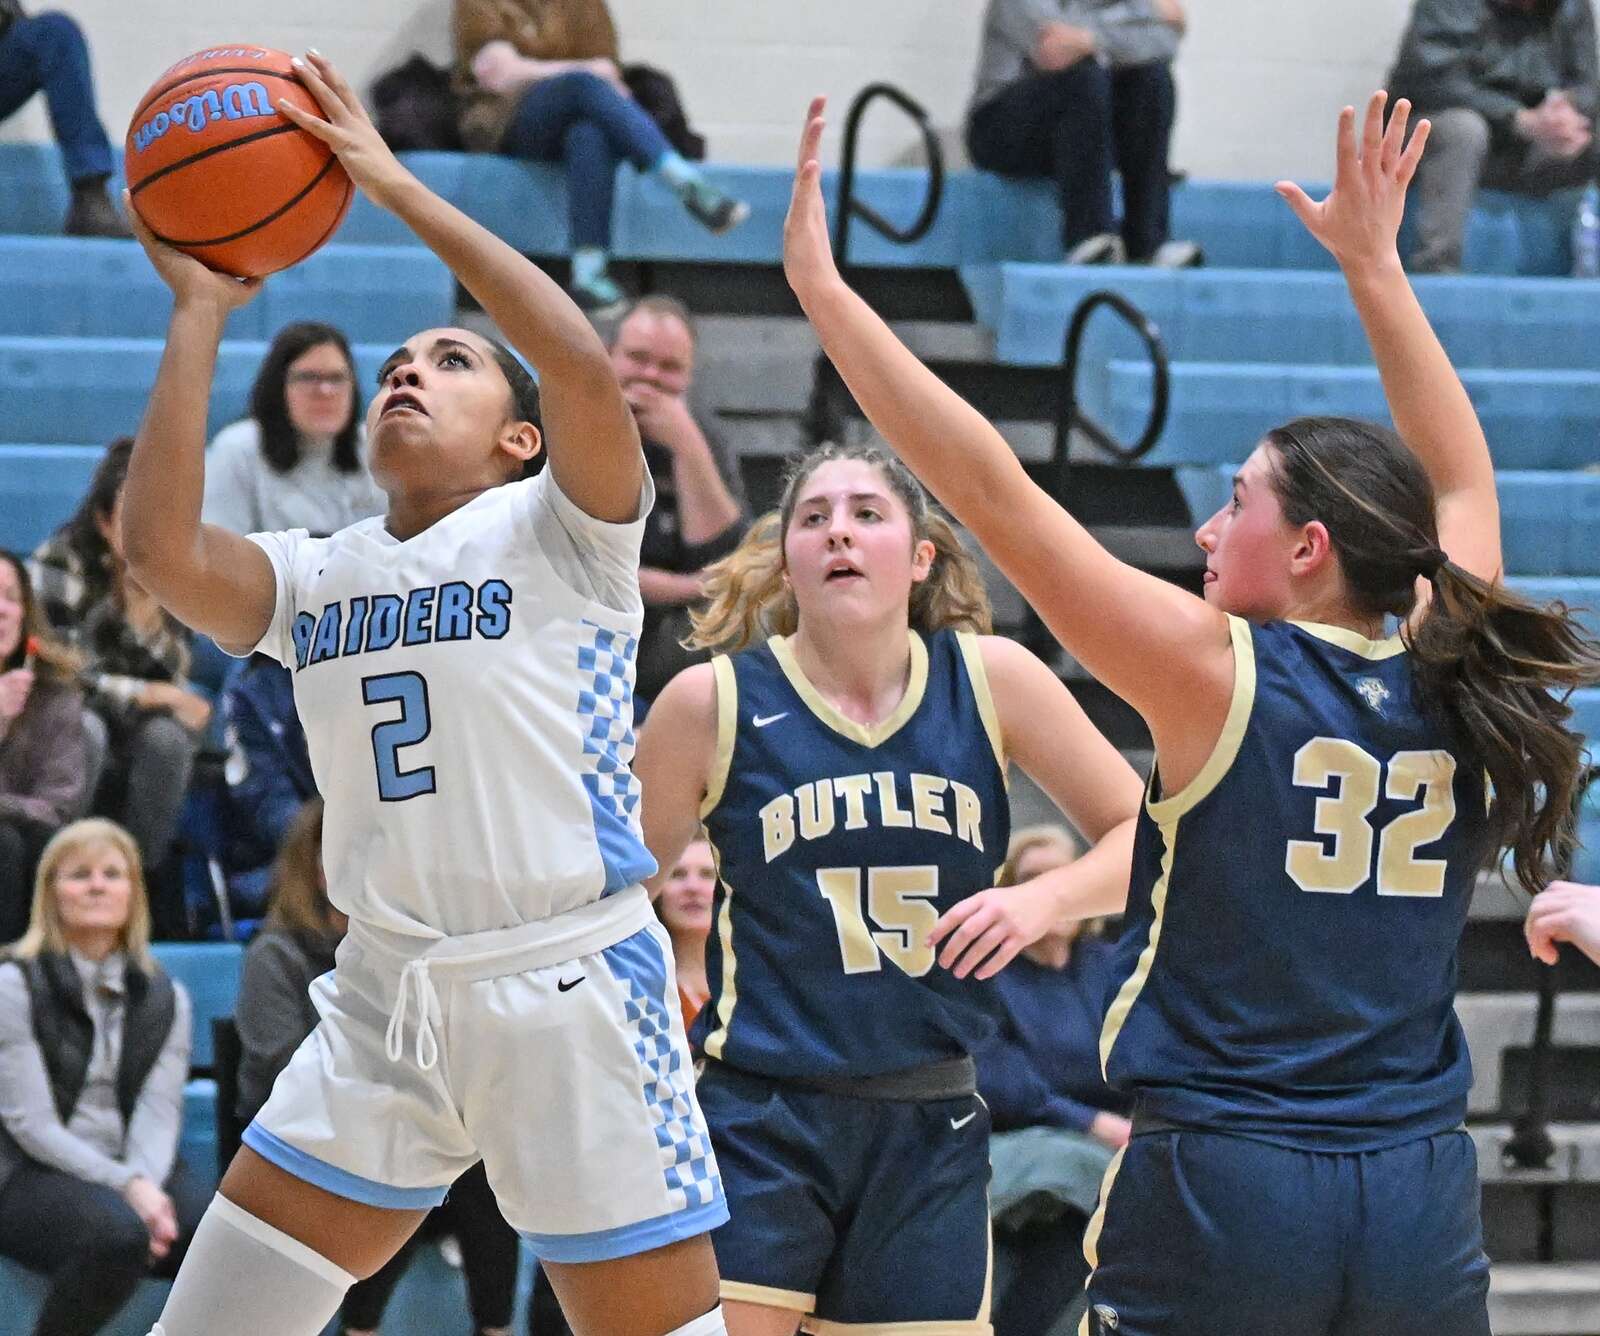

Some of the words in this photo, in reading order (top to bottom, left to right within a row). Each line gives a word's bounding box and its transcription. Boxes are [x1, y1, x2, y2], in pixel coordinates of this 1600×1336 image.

[133, 81, 277, 153] Wilson
[291, 579, 513, 672] RAIDERS
[361, 670, 436, 802] 2
[758, 771, 985, 864] BUTLER
[1285, 736, 1457, 898] 32
[816, 865, 940, 978] 15
